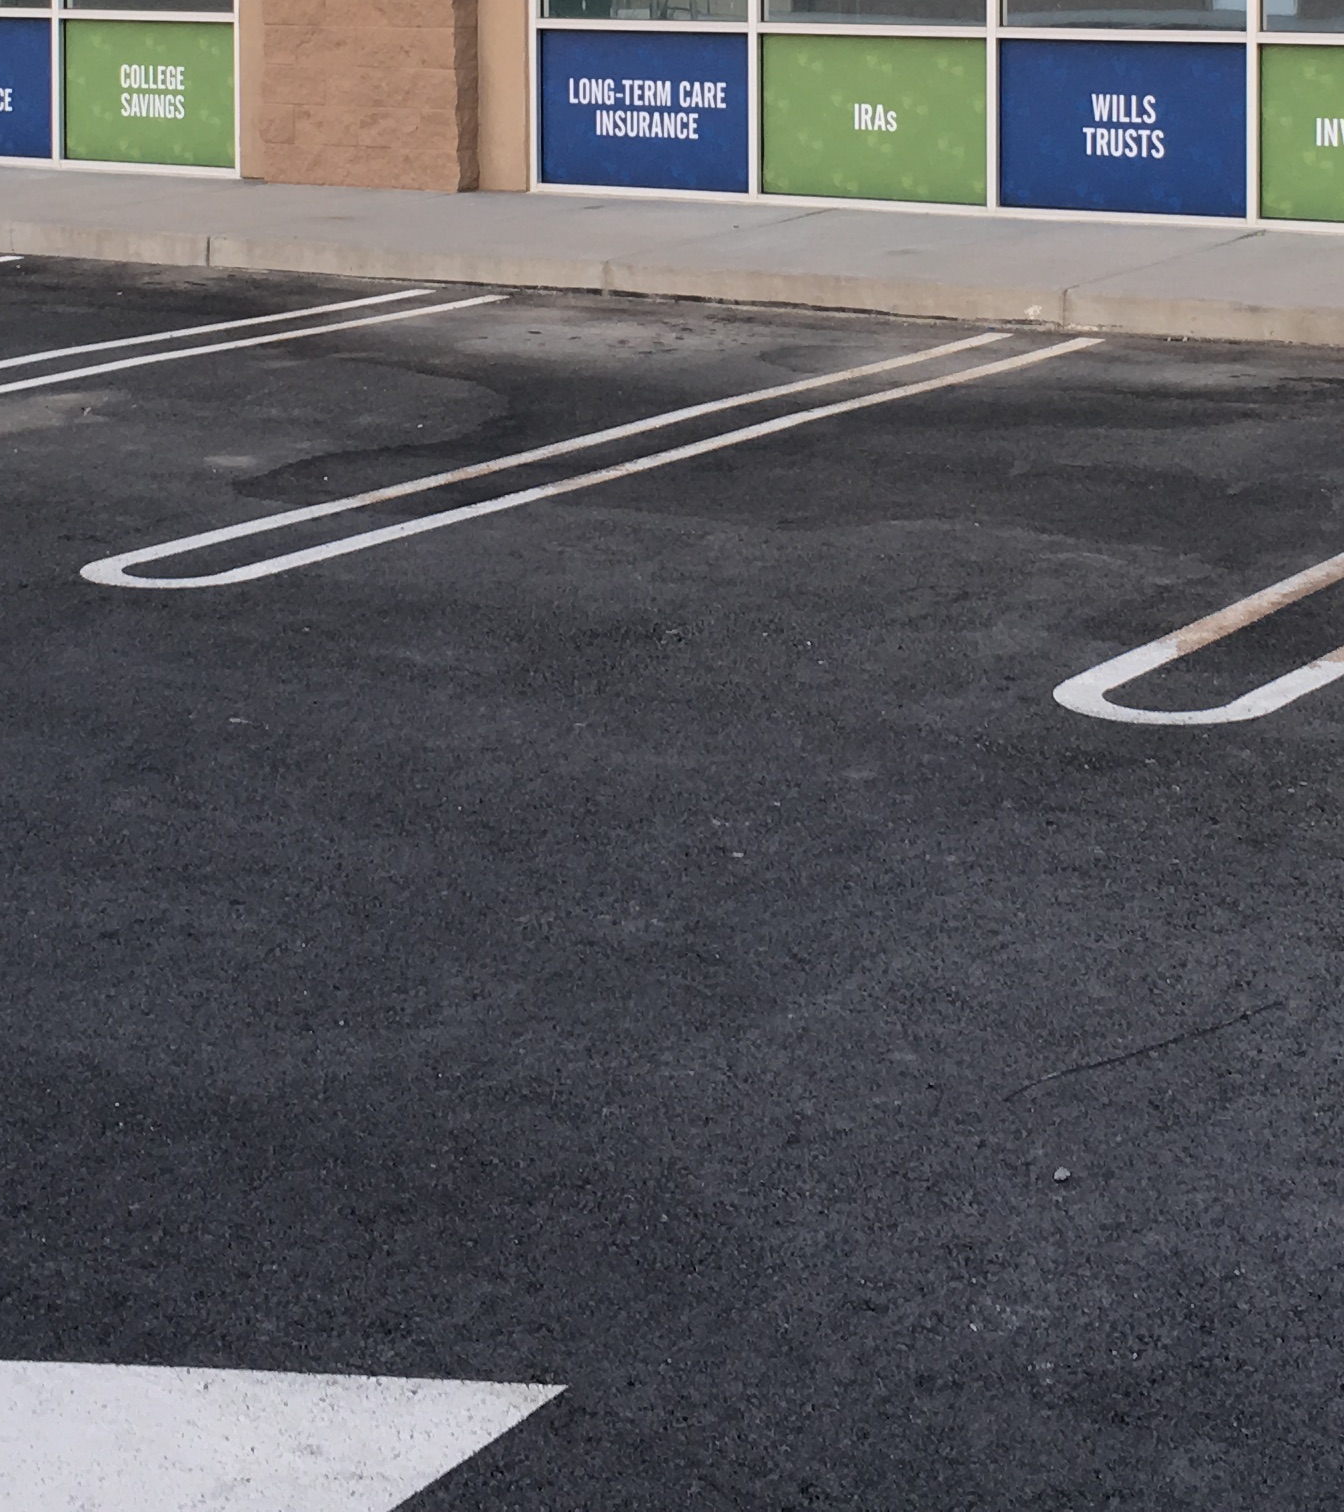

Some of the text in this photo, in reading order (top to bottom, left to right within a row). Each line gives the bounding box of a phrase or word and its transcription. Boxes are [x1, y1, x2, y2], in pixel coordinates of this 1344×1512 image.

[120, 64, 186, 91] COLLEGE
[568, 77, 727, 109] LONG-TERM CARE
[120, 93, 185, 120] SAVINGS
[853, 103, 898, 133] IRAs
[1091, 93, 1157, 124] WILLS
[595, 109, 699, 140] INSURANCE
[1082, 127, 1165, 159] TRUSTS
